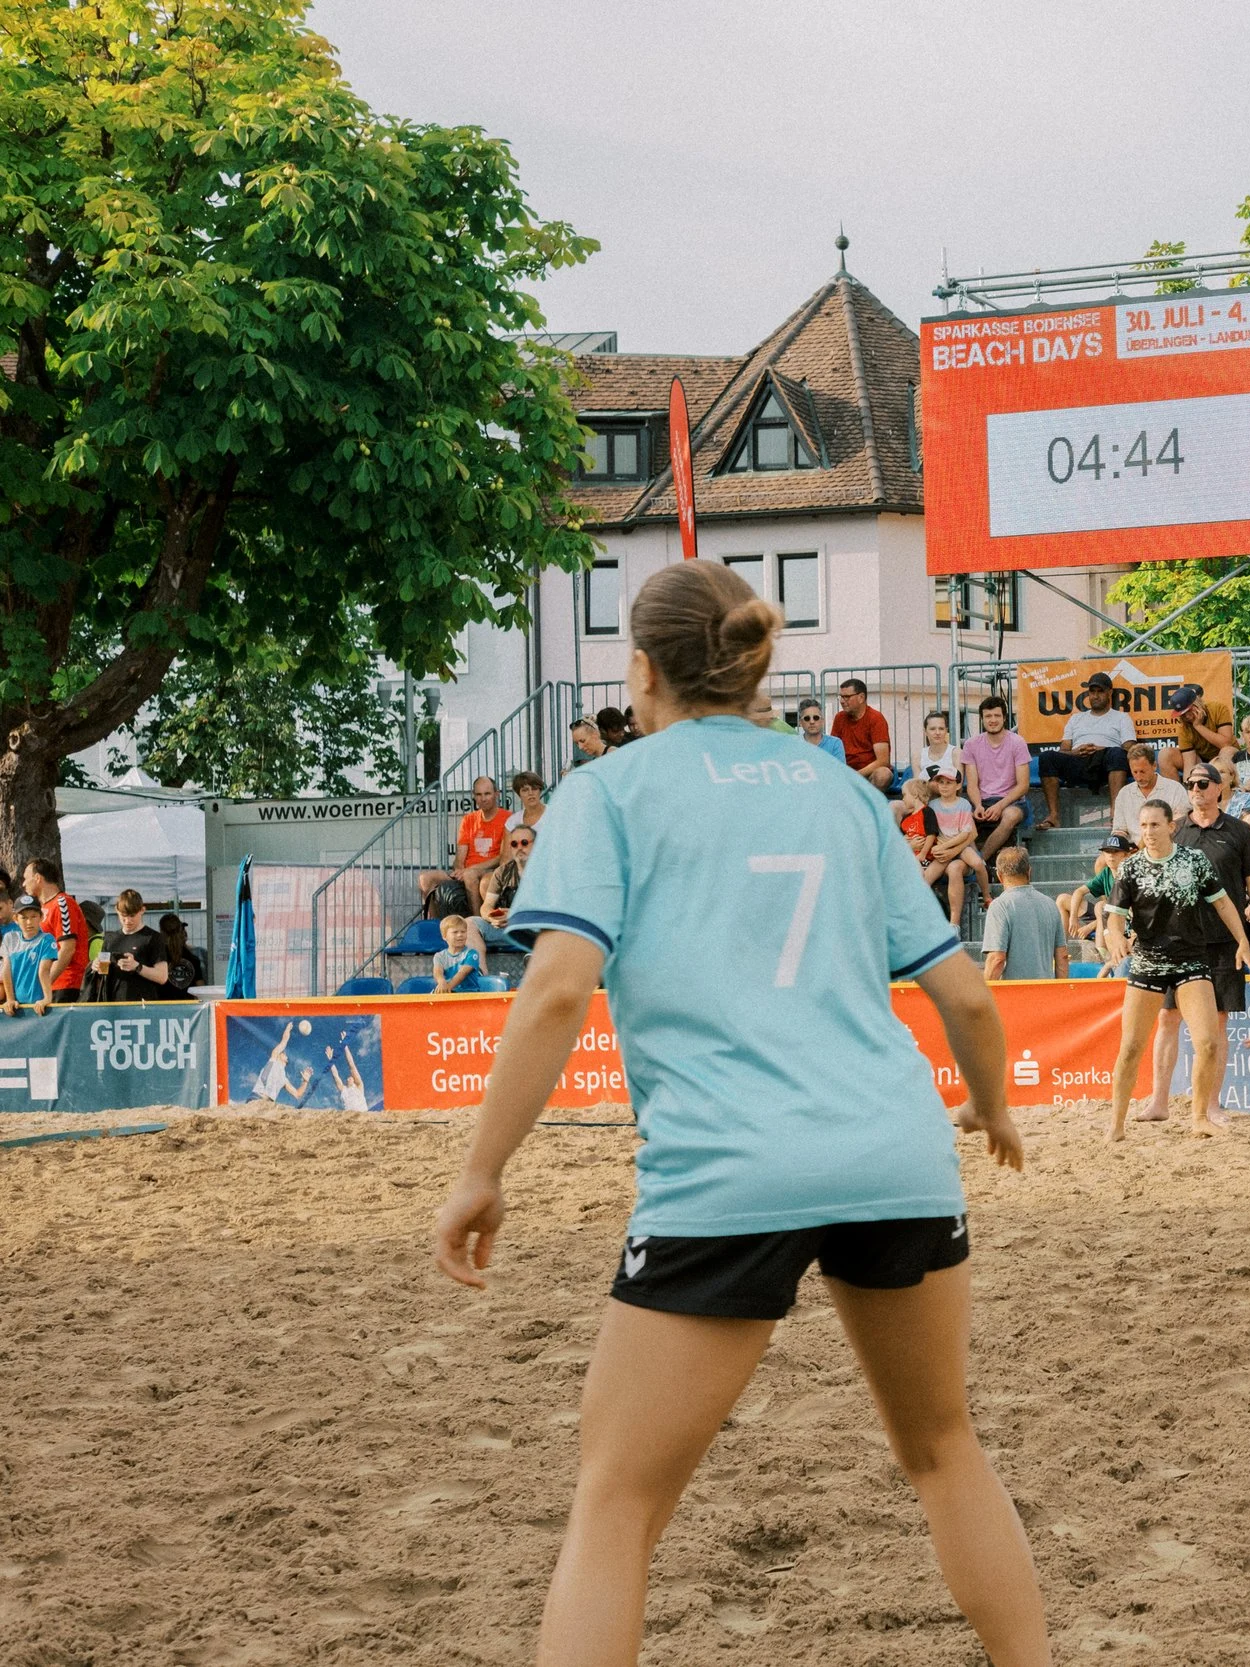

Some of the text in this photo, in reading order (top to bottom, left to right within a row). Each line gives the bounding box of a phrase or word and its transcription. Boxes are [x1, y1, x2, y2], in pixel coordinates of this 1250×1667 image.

[933, 312, 1100, 341] SPARKASSE BODENSEE
[1126, 311, 1155, 333] 30.
[1163, 305, 1204, 329] JULI
[1228, 301, 1247, 323] 4.
[932, 332, 1103, 370] BEACH DAYS
[1126, 334, 1197, 351] ÜBERLINGEN
[1047, 427, 1184, 484] 04:44
[1135, 718, 1181, 727] ÜBERLIN
[703, 752, 818, 786] Lena
[748, 853, 826, 988] 7
[90, 1018, 191, 1046] GET IN
[427, 1030, 502, 1061] Sparka
[90, 1042, 197, 1070] TOUCH
[1051, 1066, 1116, 1089] Sparka
